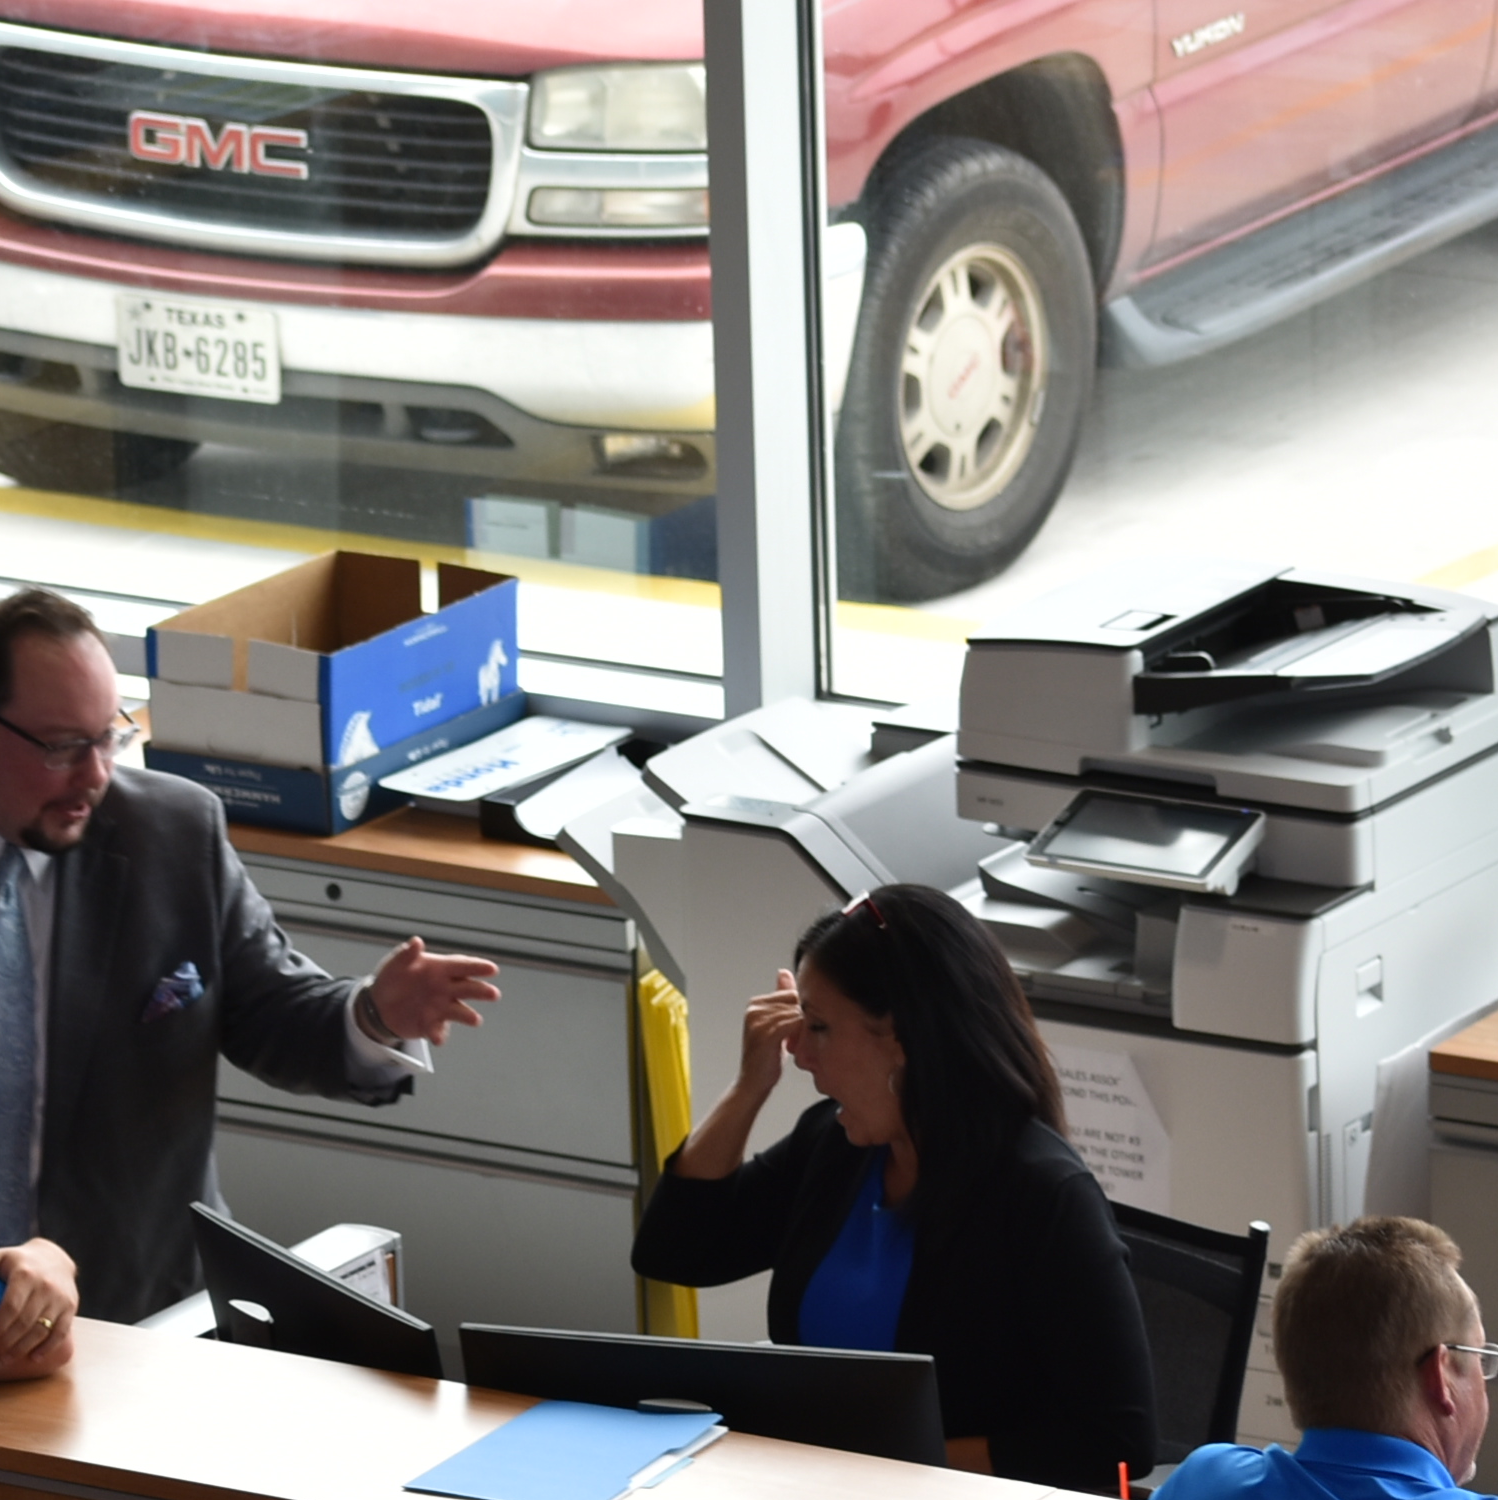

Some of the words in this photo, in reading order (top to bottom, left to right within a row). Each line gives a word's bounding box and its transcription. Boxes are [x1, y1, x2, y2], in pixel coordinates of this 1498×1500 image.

[128, 109, 309, 180] GMC
[164, 307, 226, 329] TEXAS
[425, 759, 520, 793] Honda
[1059, 1067, 1088, 1081] SALES
[1089, 1088, 1110, 1103] THIS
[1104, 1130, 1126, 1144] NOT
[1090, 1144, 1109, 1158] THE
[1111, 1149, 1145, 1164] OTHER
[1108, 1165, 1144, 1180] TOWER
